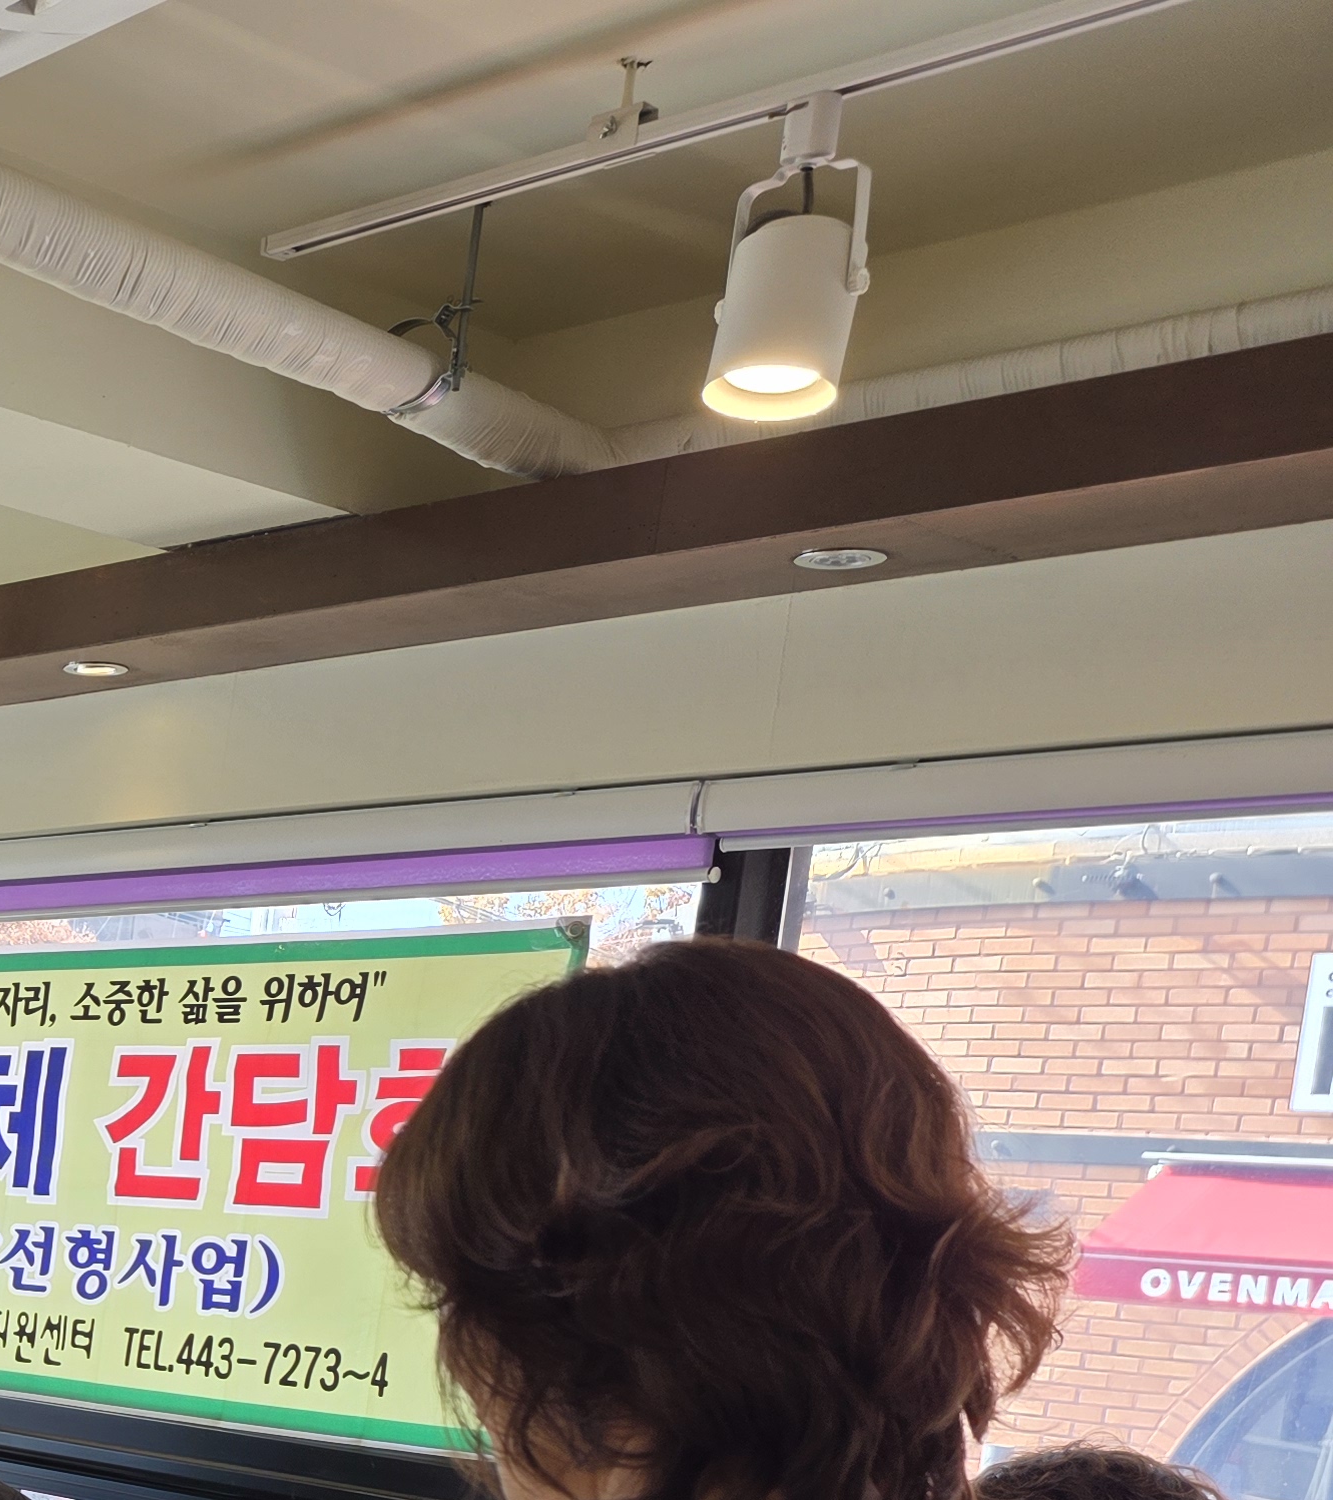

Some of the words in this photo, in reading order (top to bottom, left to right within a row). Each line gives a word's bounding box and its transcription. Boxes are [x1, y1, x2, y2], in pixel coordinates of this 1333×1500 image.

[69, 977, 169, 1026] 소중한
[178, 975, 248, 1025] 삶을
[259, 970, 387, 1023] 위하여"
[1140, 1268, 1333, 1310] OVENMA
